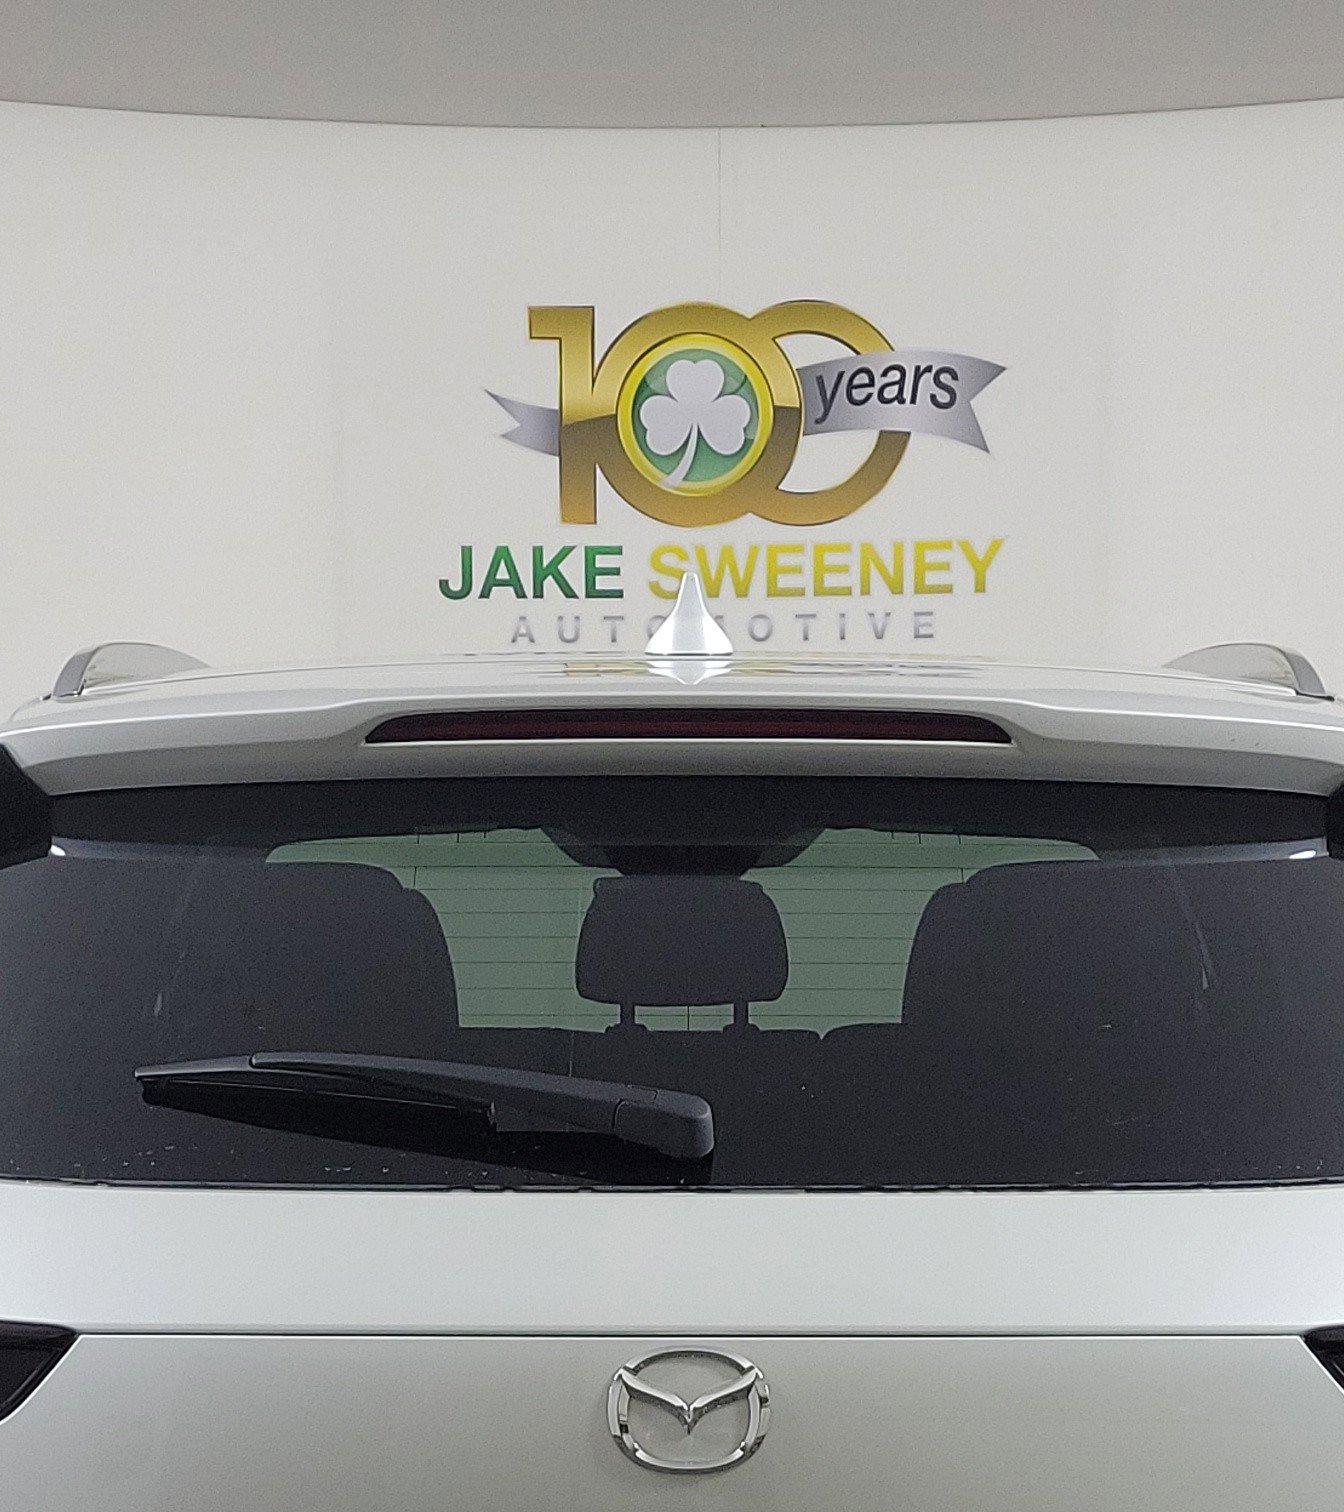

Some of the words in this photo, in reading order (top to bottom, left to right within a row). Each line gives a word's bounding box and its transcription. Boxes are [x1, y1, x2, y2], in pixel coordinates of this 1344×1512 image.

[527, 299, 912, 528] 100
[814, 362, 960, 425] years
[438, 544, 625, 601] JAKE
[647, 537, 1005, 600] SWEENEY
[510, 610, 937, 645] AUTOTIVE
